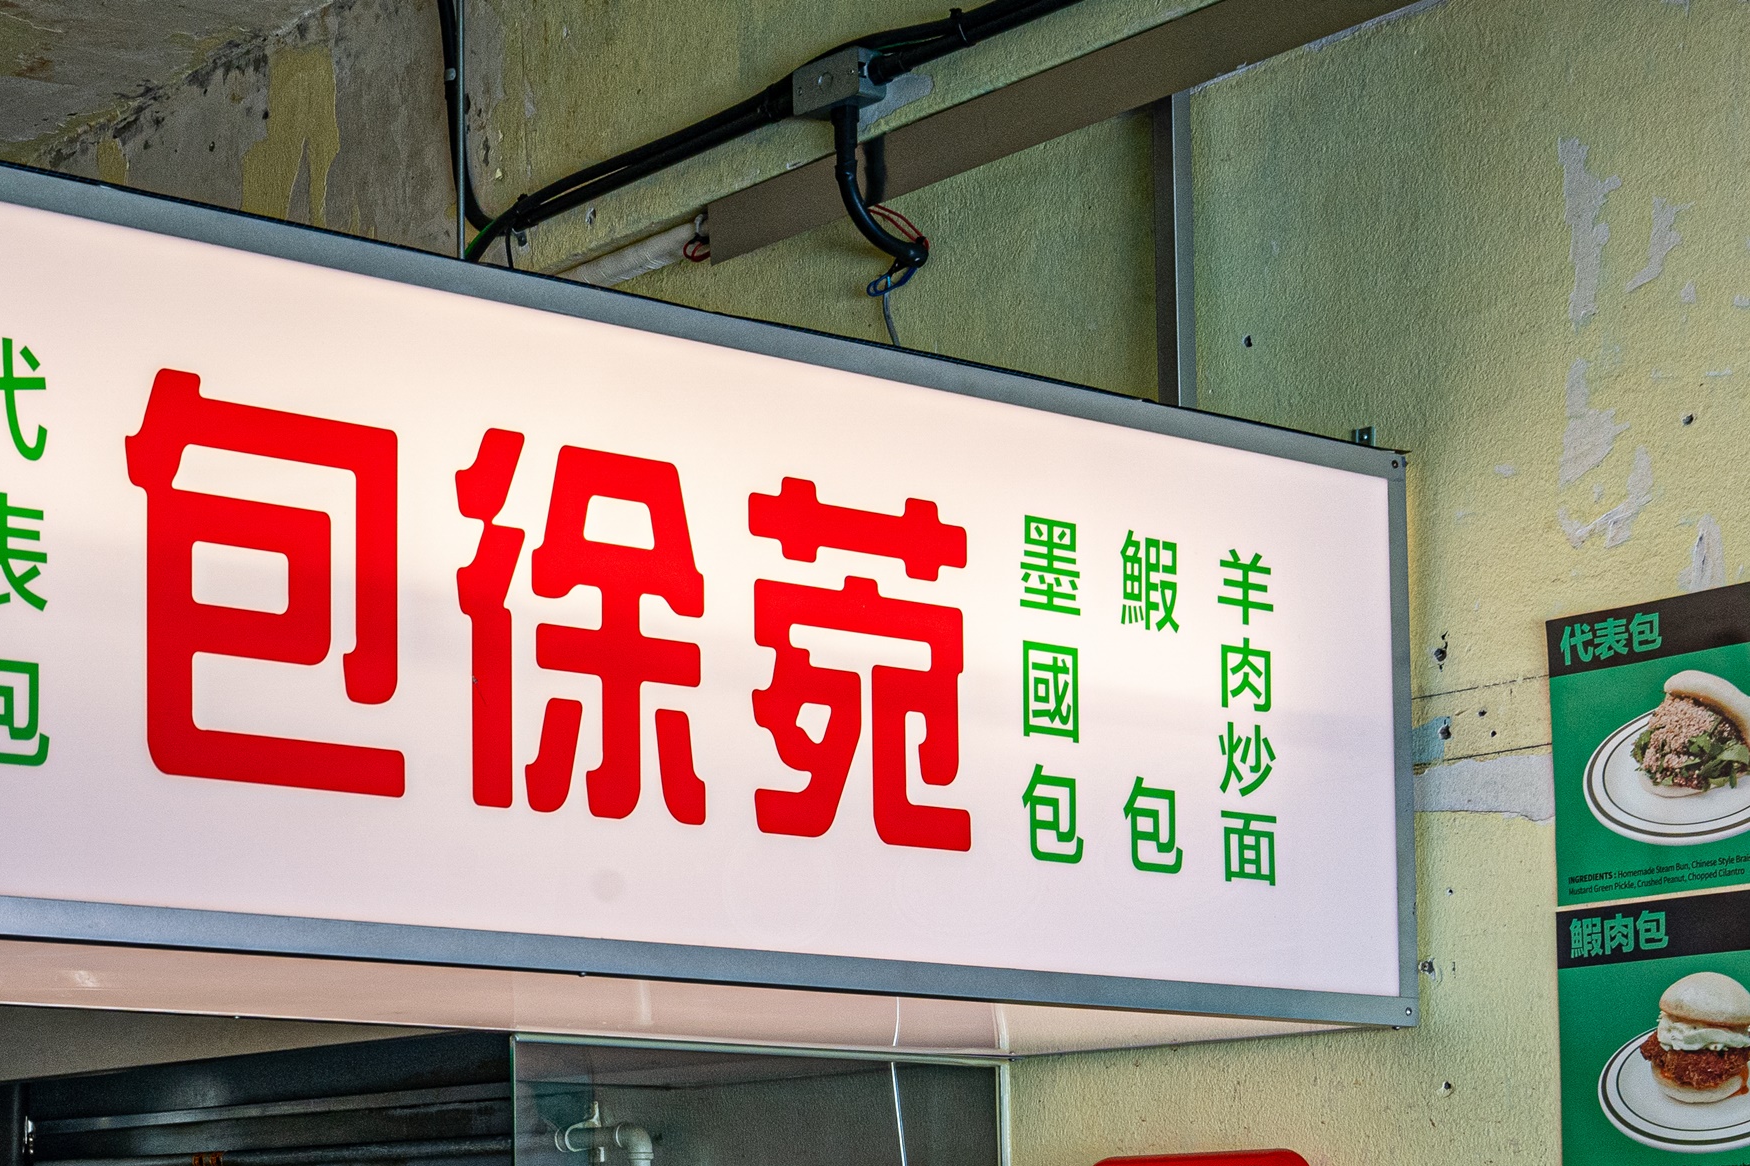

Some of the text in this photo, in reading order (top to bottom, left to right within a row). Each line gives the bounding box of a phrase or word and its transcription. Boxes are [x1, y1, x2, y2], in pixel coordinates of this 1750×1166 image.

[125, 367, 971, 852] 包徐苑
[1020, 514, 1084, 864] 墨國包
[1560, 612, 1662, 665] 代表包
[1217, 549, 1277, 886] 羊肉炒面
[1568, 872, 1612, 884] INGREDIENTS
[1618, 867, 1654, 878] Homemade
[1656, 865, 1675, 875] Steam
[1692, 859, 1717, 869] Chinese
[1718, 856, 1734, 866] Style
[1614, 881, 1636, 889] Pickle,
[1638, 879, 1662, 888] Crushed
[1664, 876, 1687, 884] Peanut,
[1688, 872, 1717, 881] Chopped
[1718, 868, 1745, 877] Cilantro
